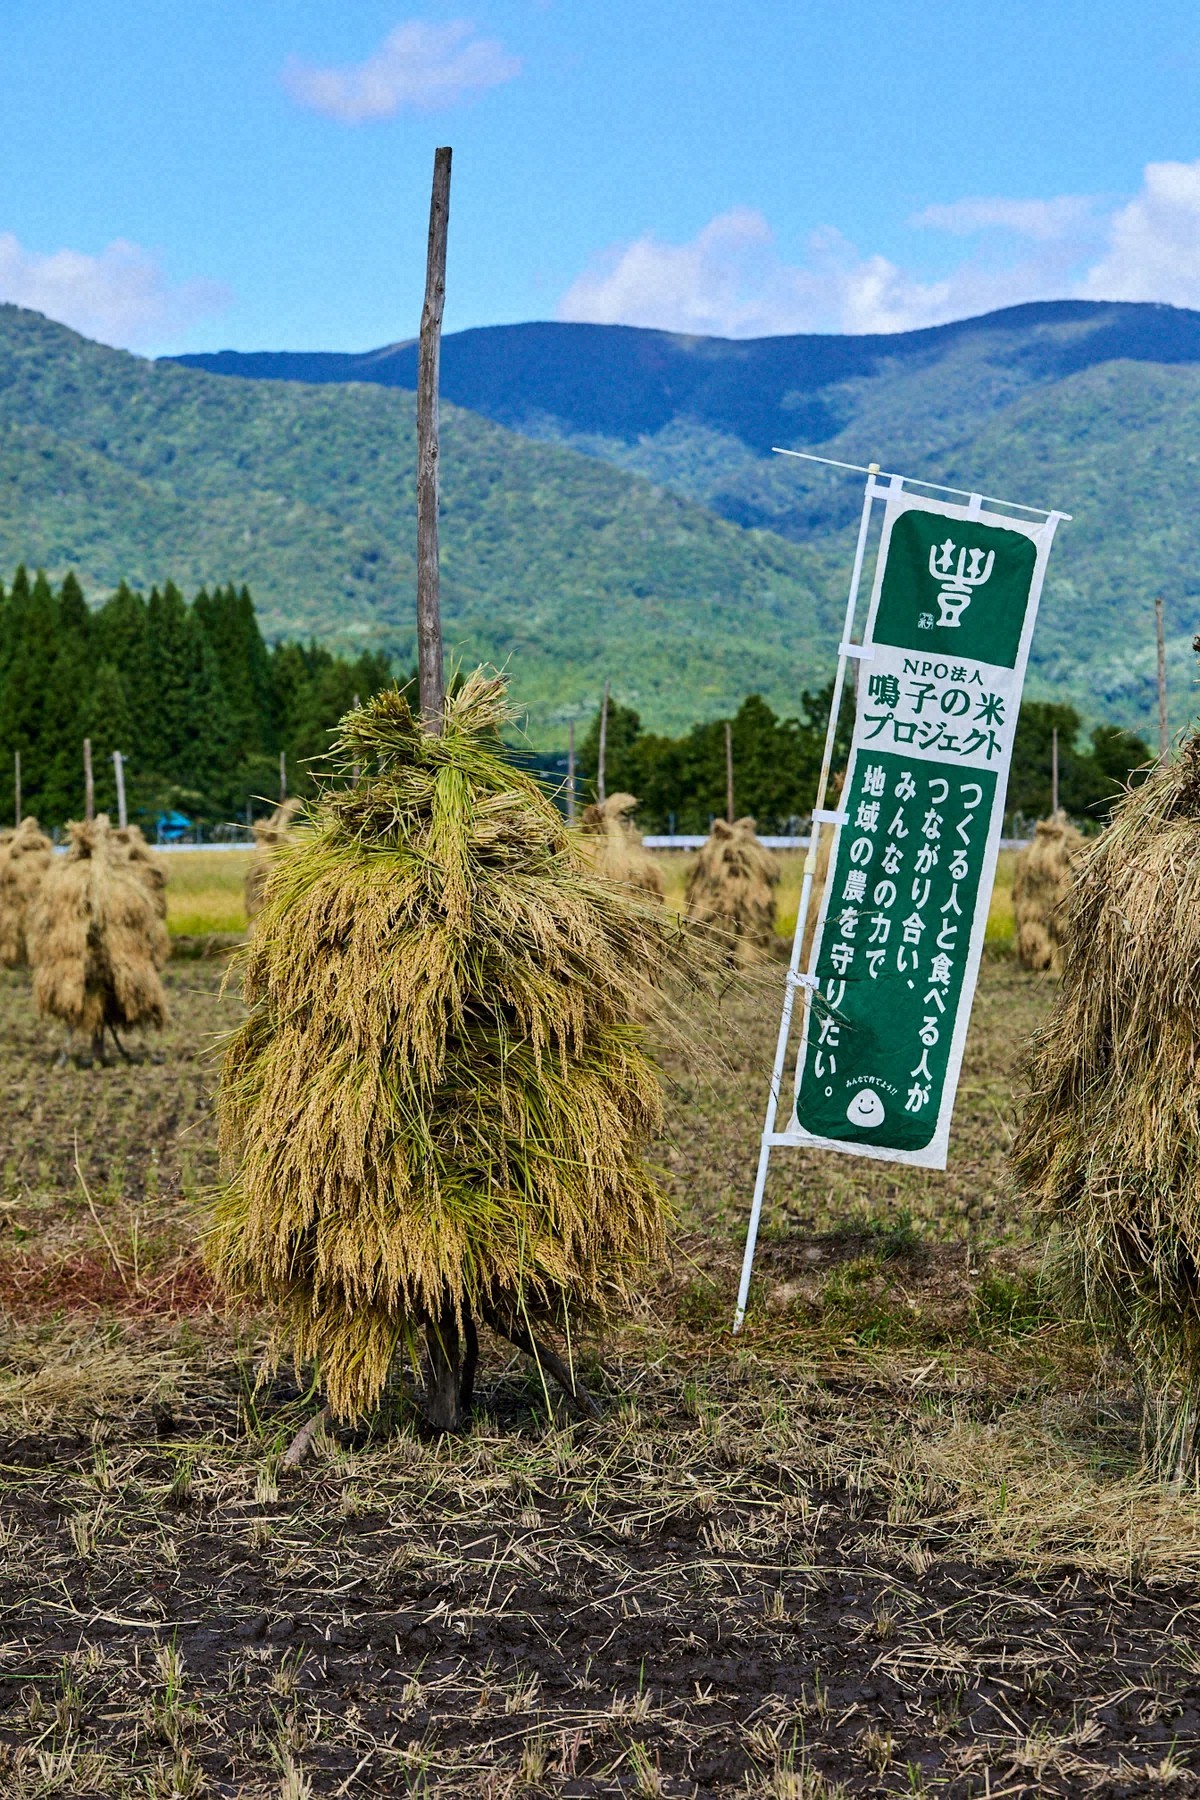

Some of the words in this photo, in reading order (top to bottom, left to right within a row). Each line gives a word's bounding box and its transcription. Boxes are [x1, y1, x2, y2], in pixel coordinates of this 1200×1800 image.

[863, 712, 1002, 761] プロジェクト
[868, 673, 1006, 727] 鳴子の米
[902, 658, 984, 686] NPO法人
[814, 764, 887, 1098] 地域の農を守りたい。
[865, 771, 917, 979] みんなの力で
[896, 777, 949, 990] つながり合い、
[904, 782, 983, 1113] つくる人と食べる人が
